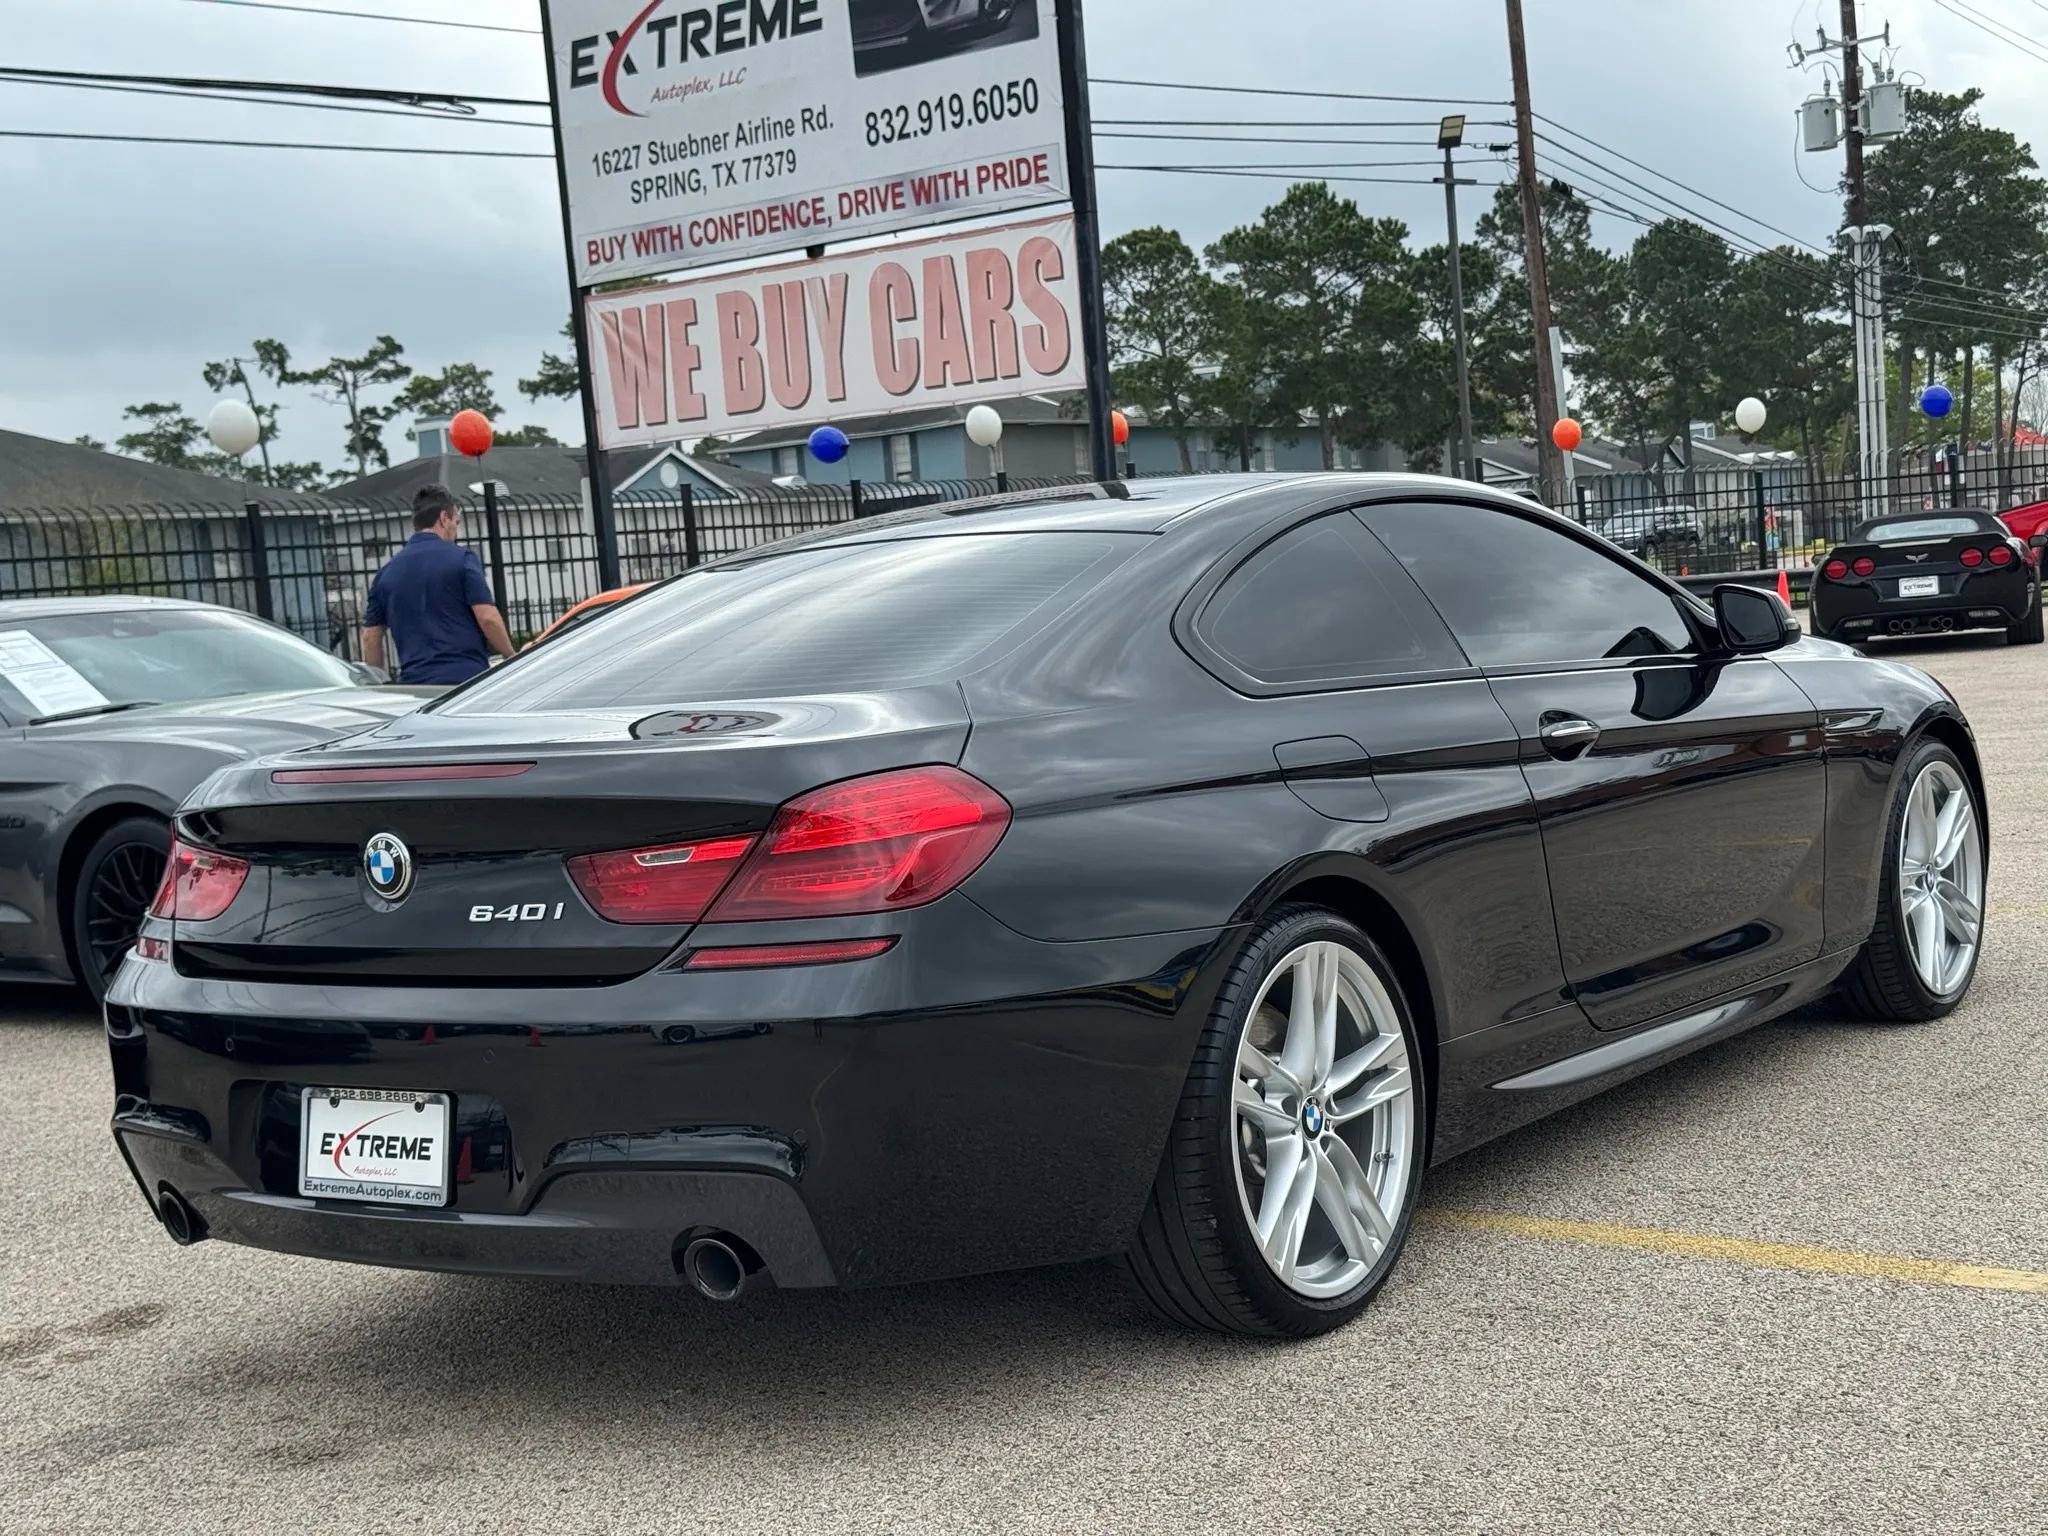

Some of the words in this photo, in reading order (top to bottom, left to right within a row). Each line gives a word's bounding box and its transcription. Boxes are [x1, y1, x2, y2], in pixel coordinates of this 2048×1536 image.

[570, 0, 823, 89] EXTREME
[650, 76, 713, 103] Autoplex,
[718, 67, 748, 88] LLC
[865, 77, 1039, 147] 832.919.6050
[592, 145, 641, 177] 16227
[648, 131, 730, 166] Stuebner
[735, 116, 795, 148] Airline
[801, 104, 834, 134] Rd.
[631, 168, 707, 204] SPRING,
[712, 159, 737, 188] TX
[742, 149, 797, 183] 77379
[587, 234, 627, 266] BUY
[632, 224, 684, 258] WITH
[689, 197, 833, 247] CONFIDENCE,
[838, 181, 906, 220] DRIVE
[910, 168, 969, 206] WITH
[976, 153, 1050, 194] PRIDE
[601, 298, 707, 431] WE
[716, 271, 849, 416] BUY
[869, 236, 1071, 396] CARS
[367, 839, 400, 858] BMW
[320, 1132, 434, 1161] EXTREME
[304, 1180, 442, 1202] ExtremeAutoplex.com
